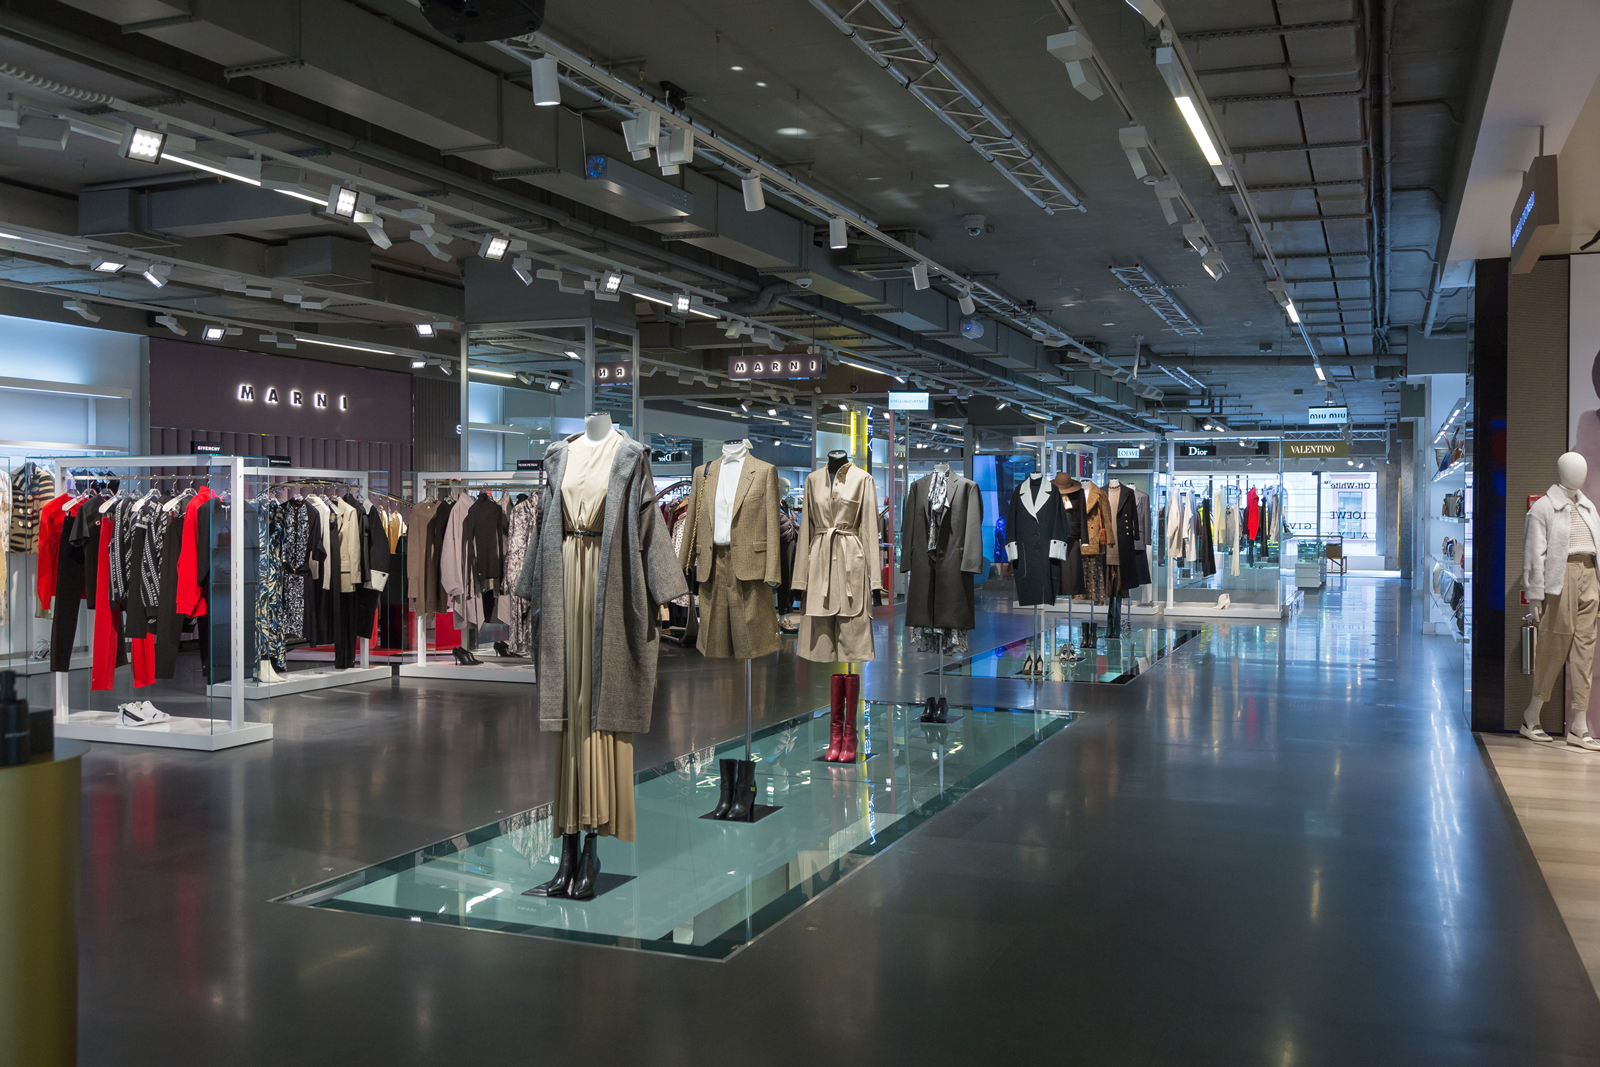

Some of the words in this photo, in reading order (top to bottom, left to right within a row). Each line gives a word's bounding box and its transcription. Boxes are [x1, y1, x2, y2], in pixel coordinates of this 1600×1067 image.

[735, 361, 816, 372] MARNI
[238, 384, 348, 411] MARNI
[1188, 446, 1208, 456] Dior
[1291, 445, 1335, 453] VALENTINO
